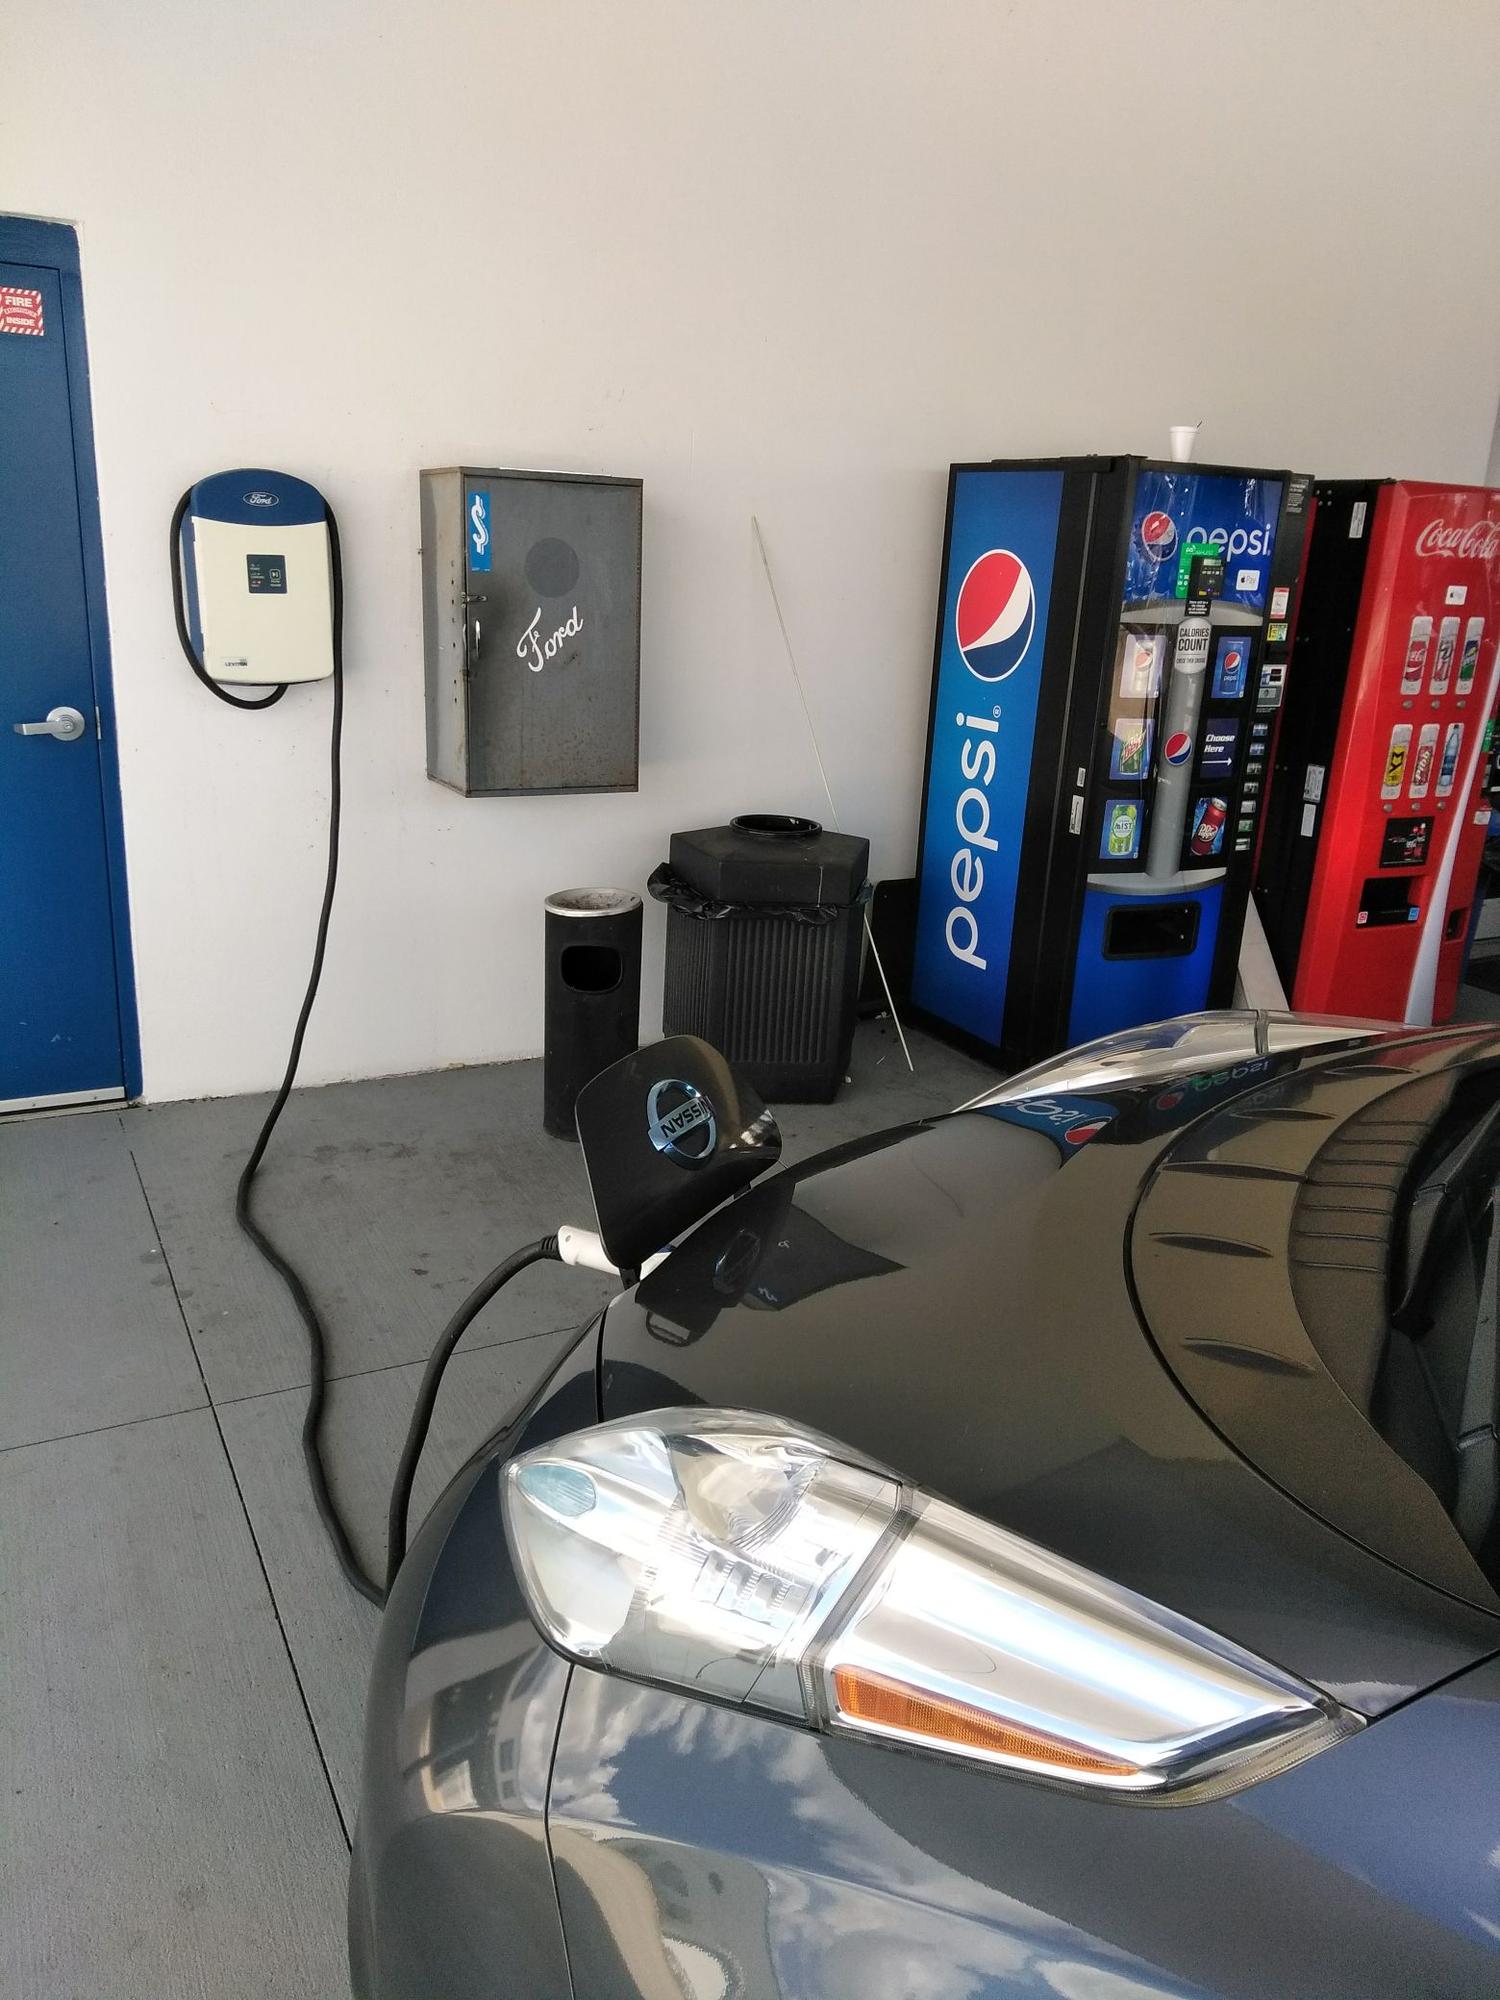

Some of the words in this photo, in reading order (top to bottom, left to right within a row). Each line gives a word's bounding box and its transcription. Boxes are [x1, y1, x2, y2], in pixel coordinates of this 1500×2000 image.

[5, 295, 33, 307] FIRE
[6, 316, 35, 326] INSIDE
[249, 493, 273, 505] Ford
[516, 605, 585, 672] Ford
[1179, 628, 1210, 637] CALORIES
[1178, 638, 1208, 651] COUNT
[1205, 734, 1236, 742] Choose
[1203, 744, 1225, 753] Here
[946, 712, 999, 970] pepsi
[661, 1096, 713, 1139] NISSAN
